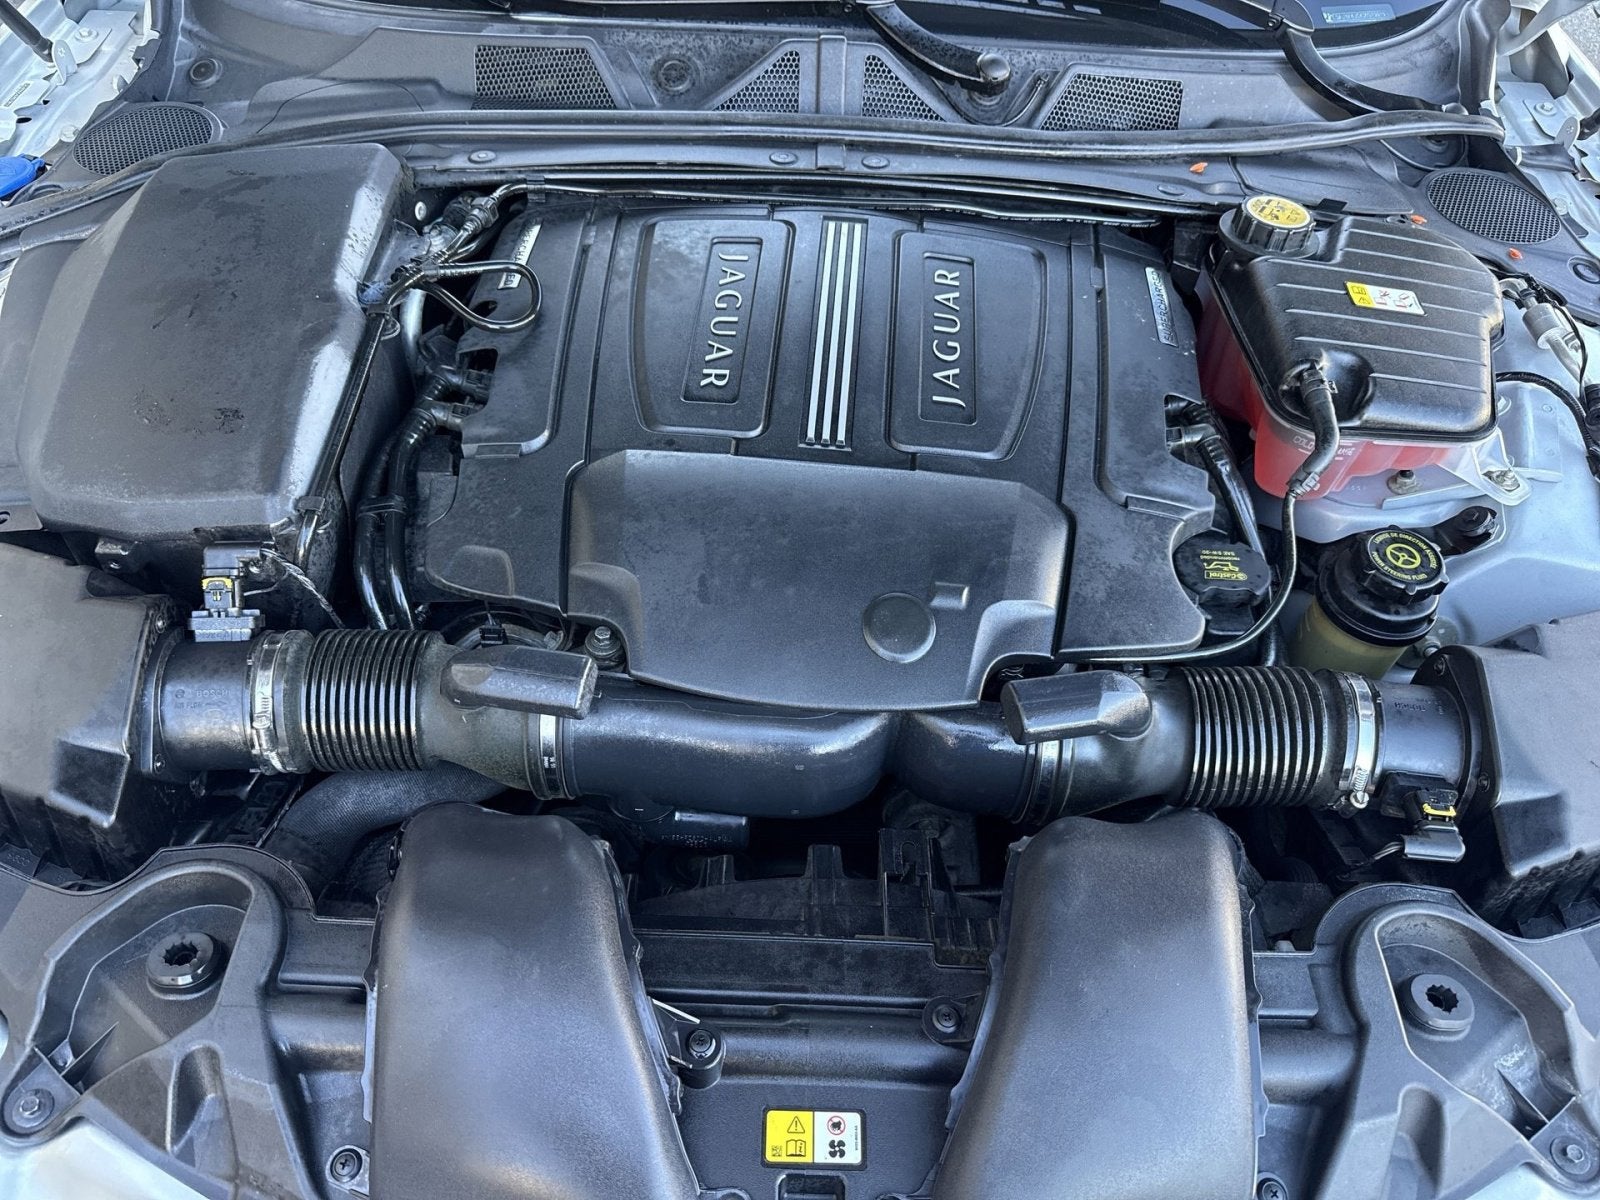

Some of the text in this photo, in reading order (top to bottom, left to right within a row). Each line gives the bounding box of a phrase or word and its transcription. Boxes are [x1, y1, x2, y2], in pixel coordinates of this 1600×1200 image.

[700, 252, 749, 387] JAGUAR
[1152, 270, 1172, 341] SUPERCHARGED
[932, 269, 966, 408] JAGUAR
[1293, 435, 1315, 449] COLD
[1384, 566, 1411, 580] STEERING
[196, 689, 231, 698] BOSCH
